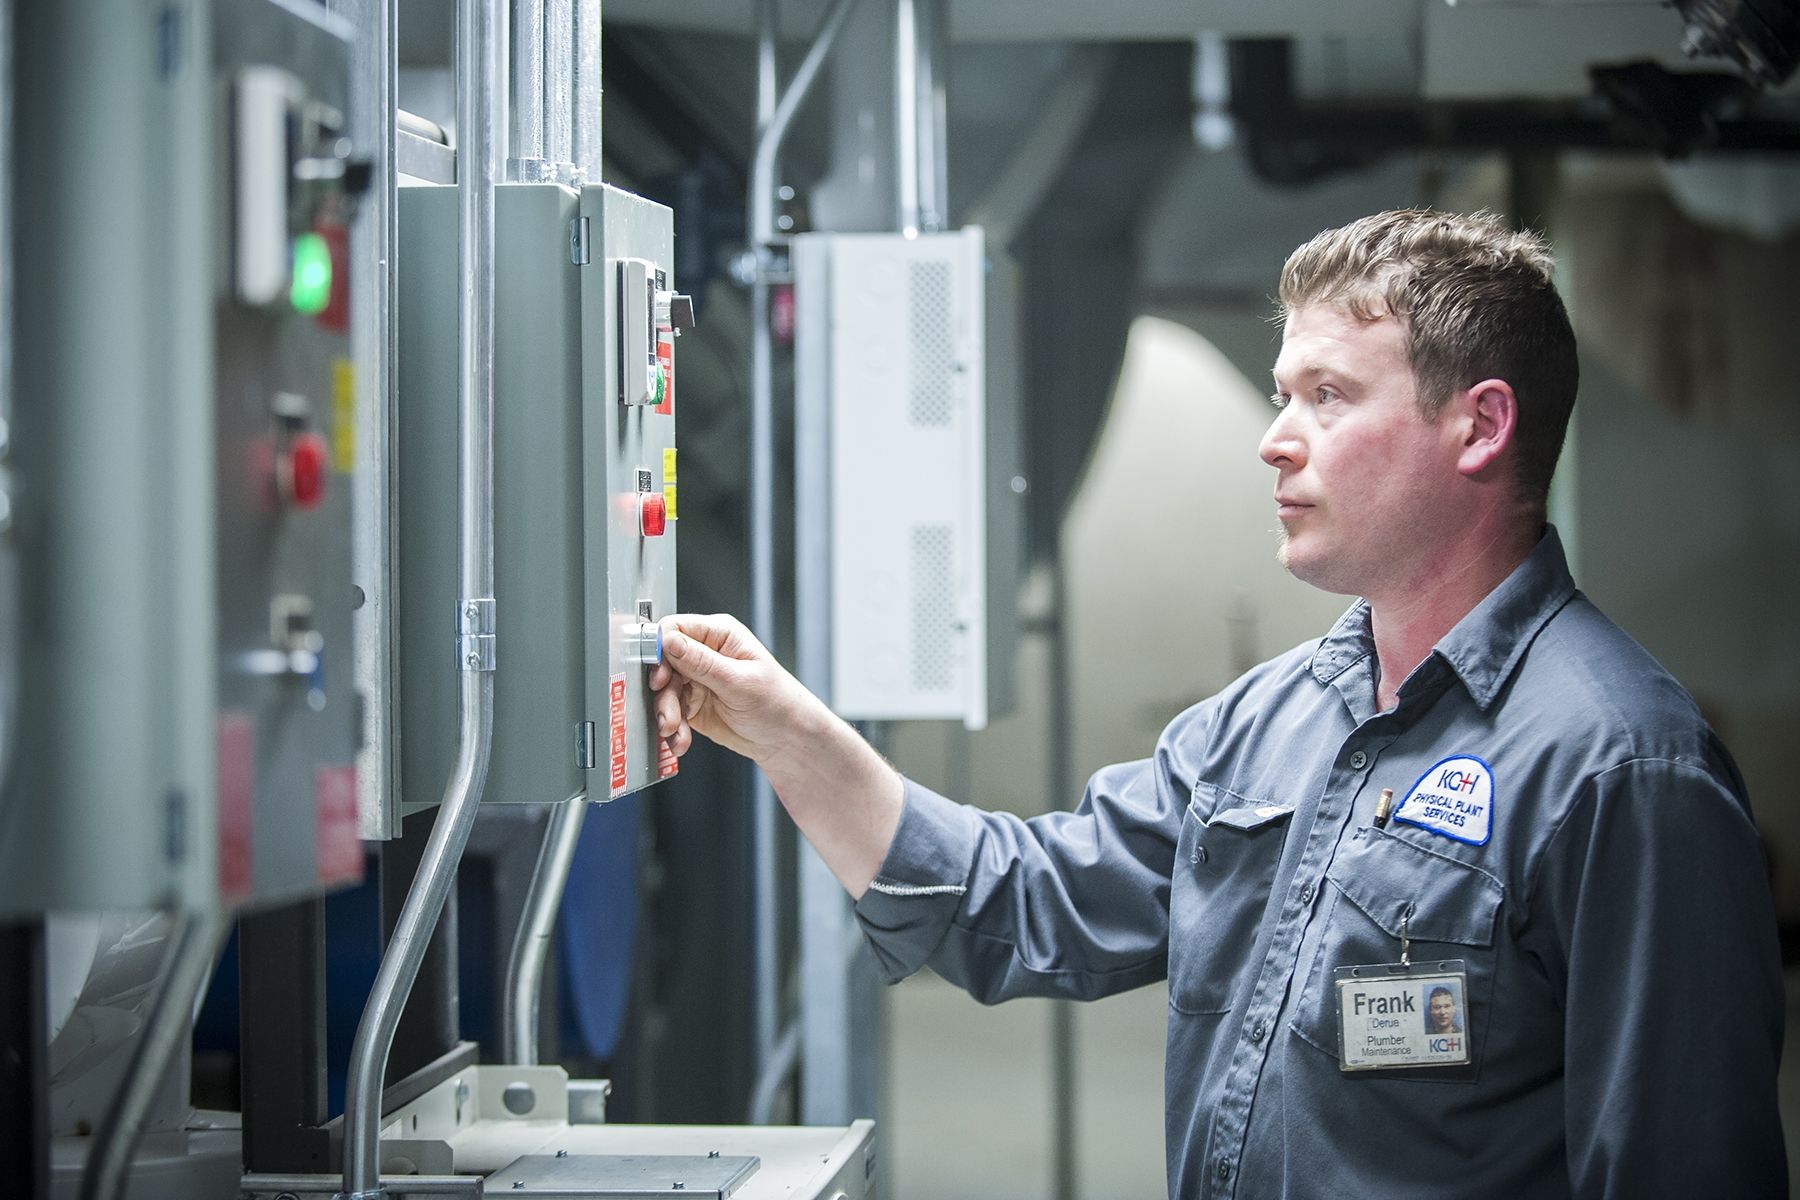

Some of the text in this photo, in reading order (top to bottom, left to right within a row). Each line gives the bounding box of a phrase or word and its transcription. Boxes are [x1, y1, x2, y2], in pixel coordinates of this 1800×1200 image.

[1413, 793, 1484, 818] PHYSICAL PLANT
[1423, 806, 1466, 828] SERVICES
[1354, 990, 1415, 1016] Frank
[1367, 1034, 1406, 1047] Plumber
[1361, 1047, 1412, 1058] Maintenance
